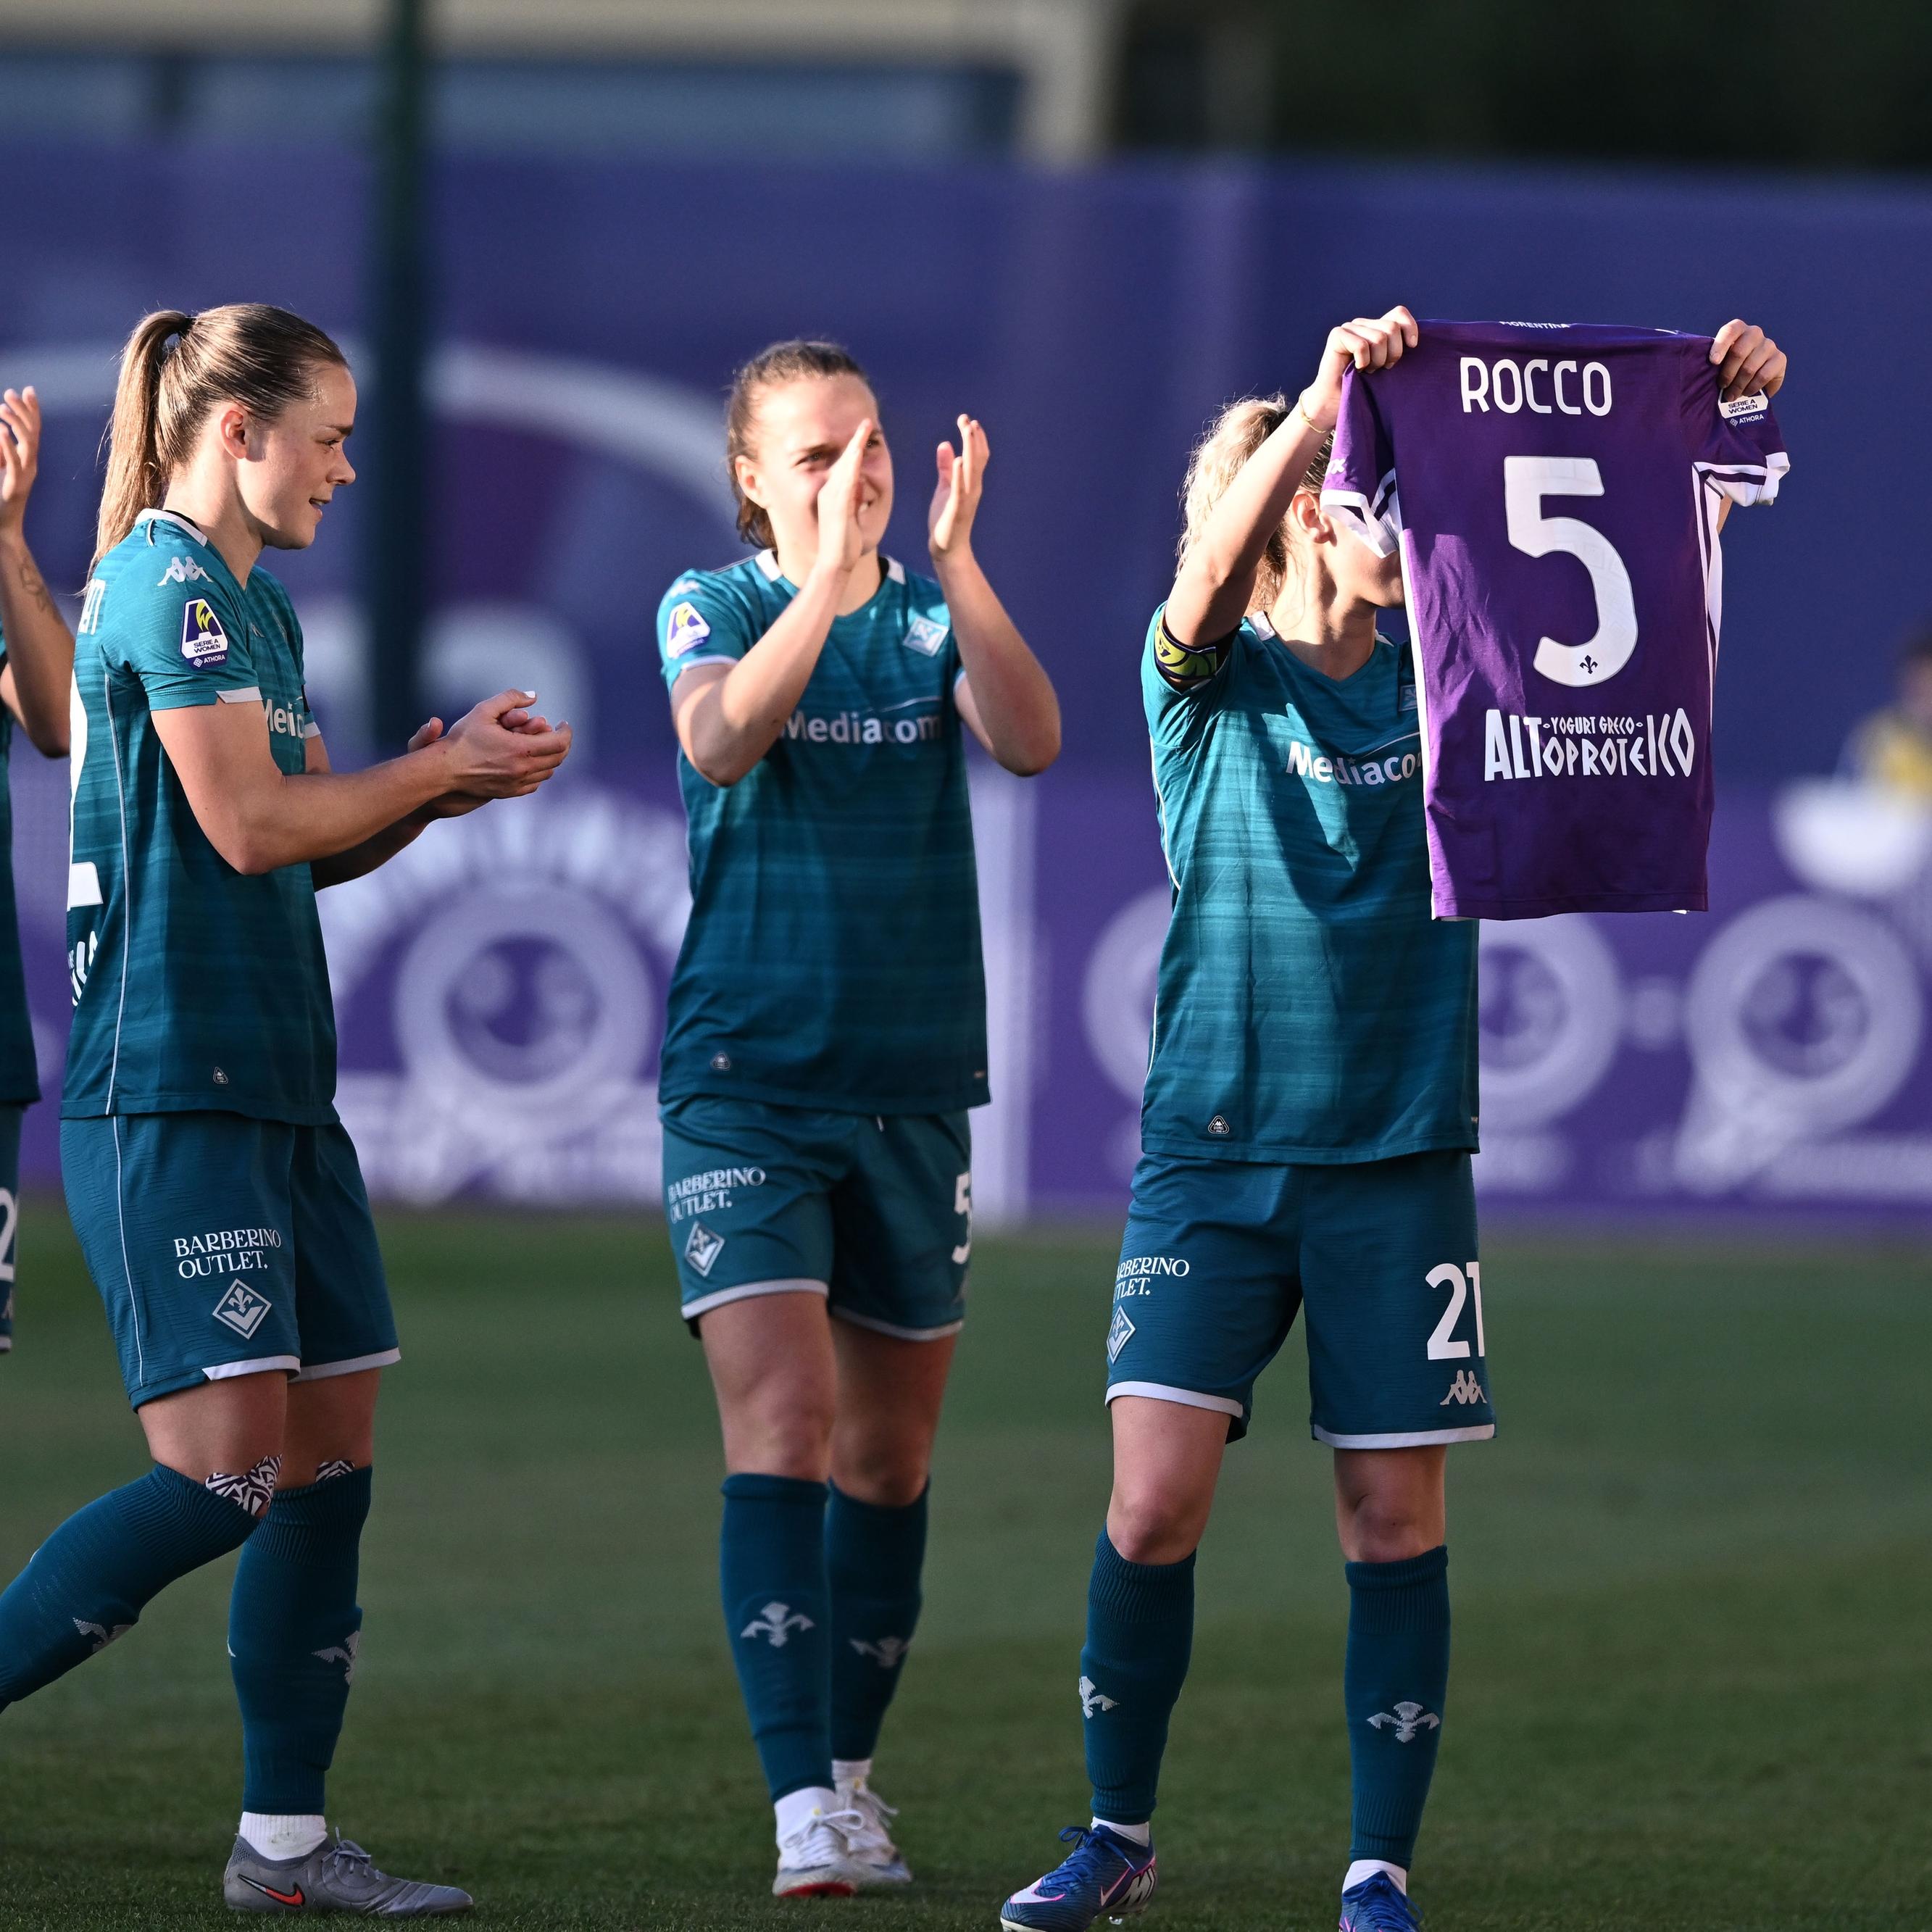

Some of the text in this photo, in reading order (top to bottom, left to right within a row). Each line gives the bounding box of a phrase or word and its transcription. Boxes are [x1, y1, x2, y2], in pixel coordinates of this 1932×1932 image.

[1460, 357, 1612, 416] ROCCO
[1728, 399, 1749, 409] SERIE
[1728, 404, 1758, 414] WOMEN
[1739, 414, 1765, 425] ATHORA
[1504, 456, 1638, 687] 5
[193, 639, 215, 648] SERIE
[193, 644, 220, 654] WOMEN
[204, 654, 226, 664] ATHORA
[1551, 716, 1634, 734] YOGURT GRECO
[1485, 708, 1694, 781] ALTOPROTEICO
[1286, 741, 1422, 785] Mediaco
[667, 1166, 766, 1205] BARBERINO
[174, 1228, 281, 1257] BARBERINO
[178, 1250, 268, 1278] OUTLET.
[1425, 1261, 1485, 1360] 21
